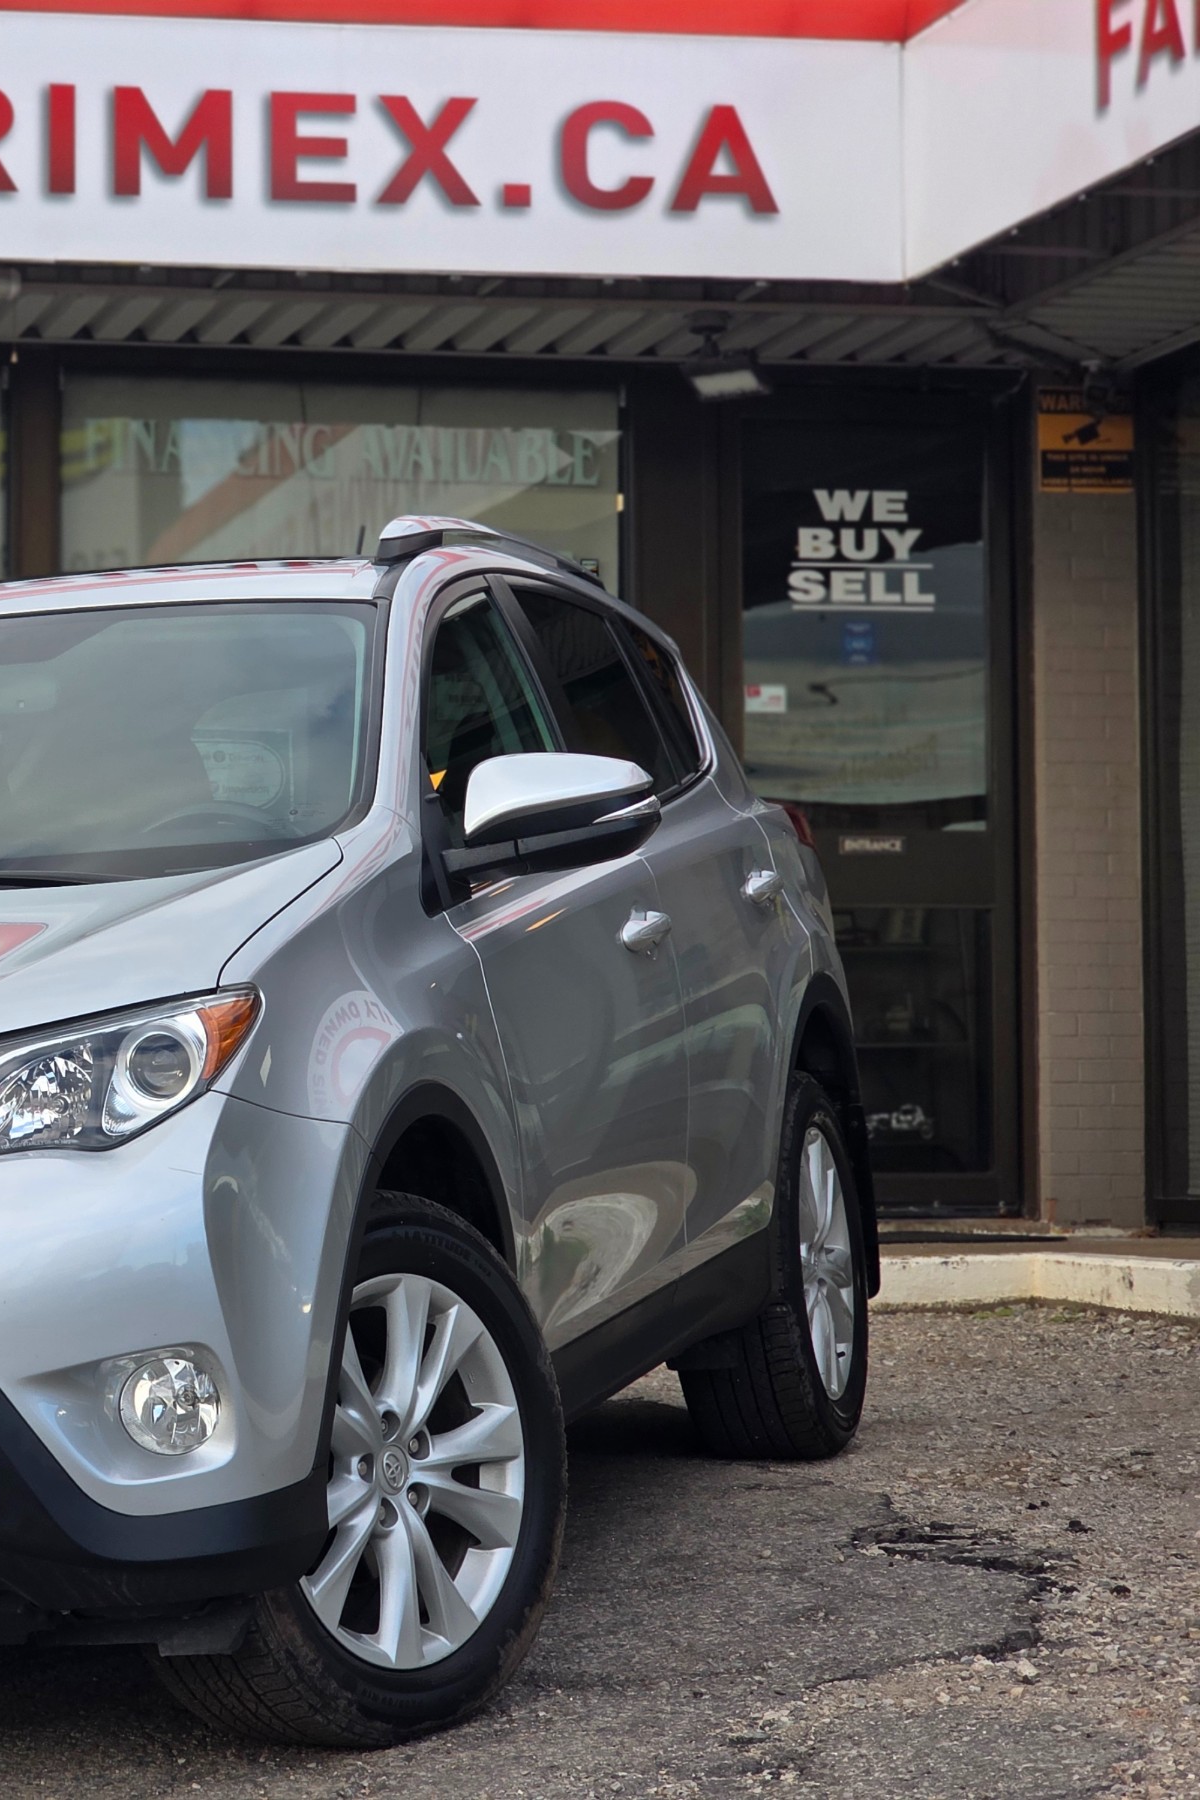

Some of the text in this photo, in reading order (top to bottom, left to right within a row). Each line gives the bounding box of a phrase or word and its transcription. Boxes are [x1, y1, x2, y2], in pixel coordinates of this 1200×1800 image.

[1097, 0, 1200, 109] FA
[359, 425, 600, 486] AVAILABLE
[813, 489, 908, 522] WE
[797, 527, 923, 560] BUY
[788, 570, 935, 603] SELL
